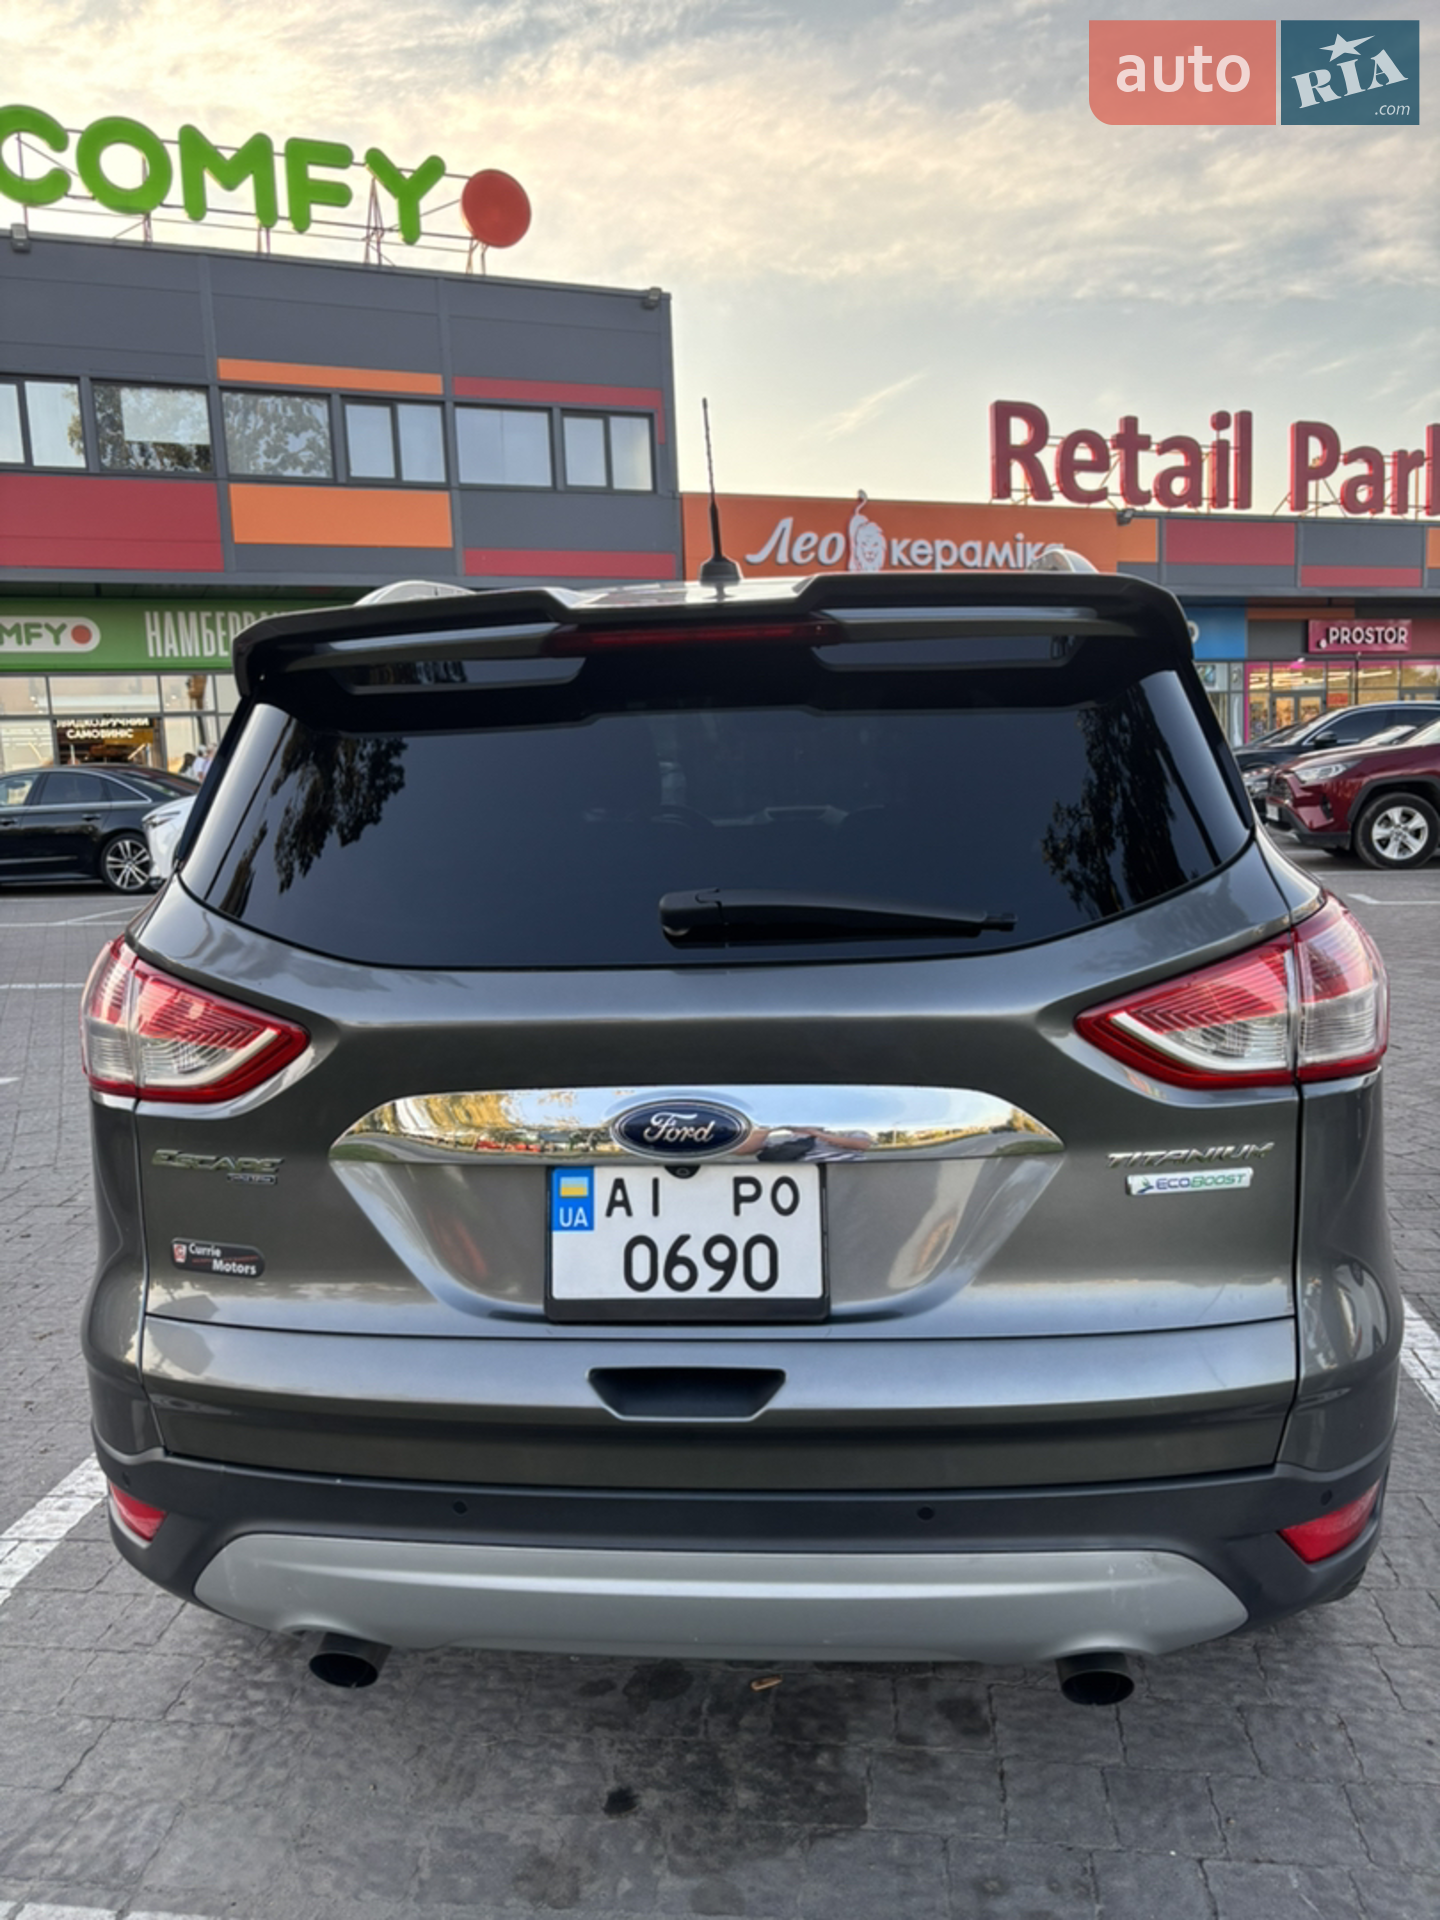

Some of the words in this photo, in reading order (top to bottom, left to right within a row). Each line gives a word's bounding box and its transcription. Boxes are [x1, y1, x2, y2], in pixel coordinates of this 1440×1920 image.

[0, 104, 446, 246] COMFY
[989, 399, 1253, 510] Retail
[745, 517, 845, 565] Лео
[890, 532, 1065, 571] керамік
[1329, 627, 1408, 645] PROSTOR
[643, 1112, 716, 1143] Ford
[152, 1149, 284, 1172] ESCAPE
[1107, 1142, 1275, 1168] TITANIUM
[605, 1177, 660, 1218] AI
[733, 1175, 800, 1217] PO
[559, 1207, 588, 1227] UA
[188, 1243, 222, 1258] Currie
[623, 1233, 779, 1293] 0690
[212, 1258, 257, 1276] Motors
